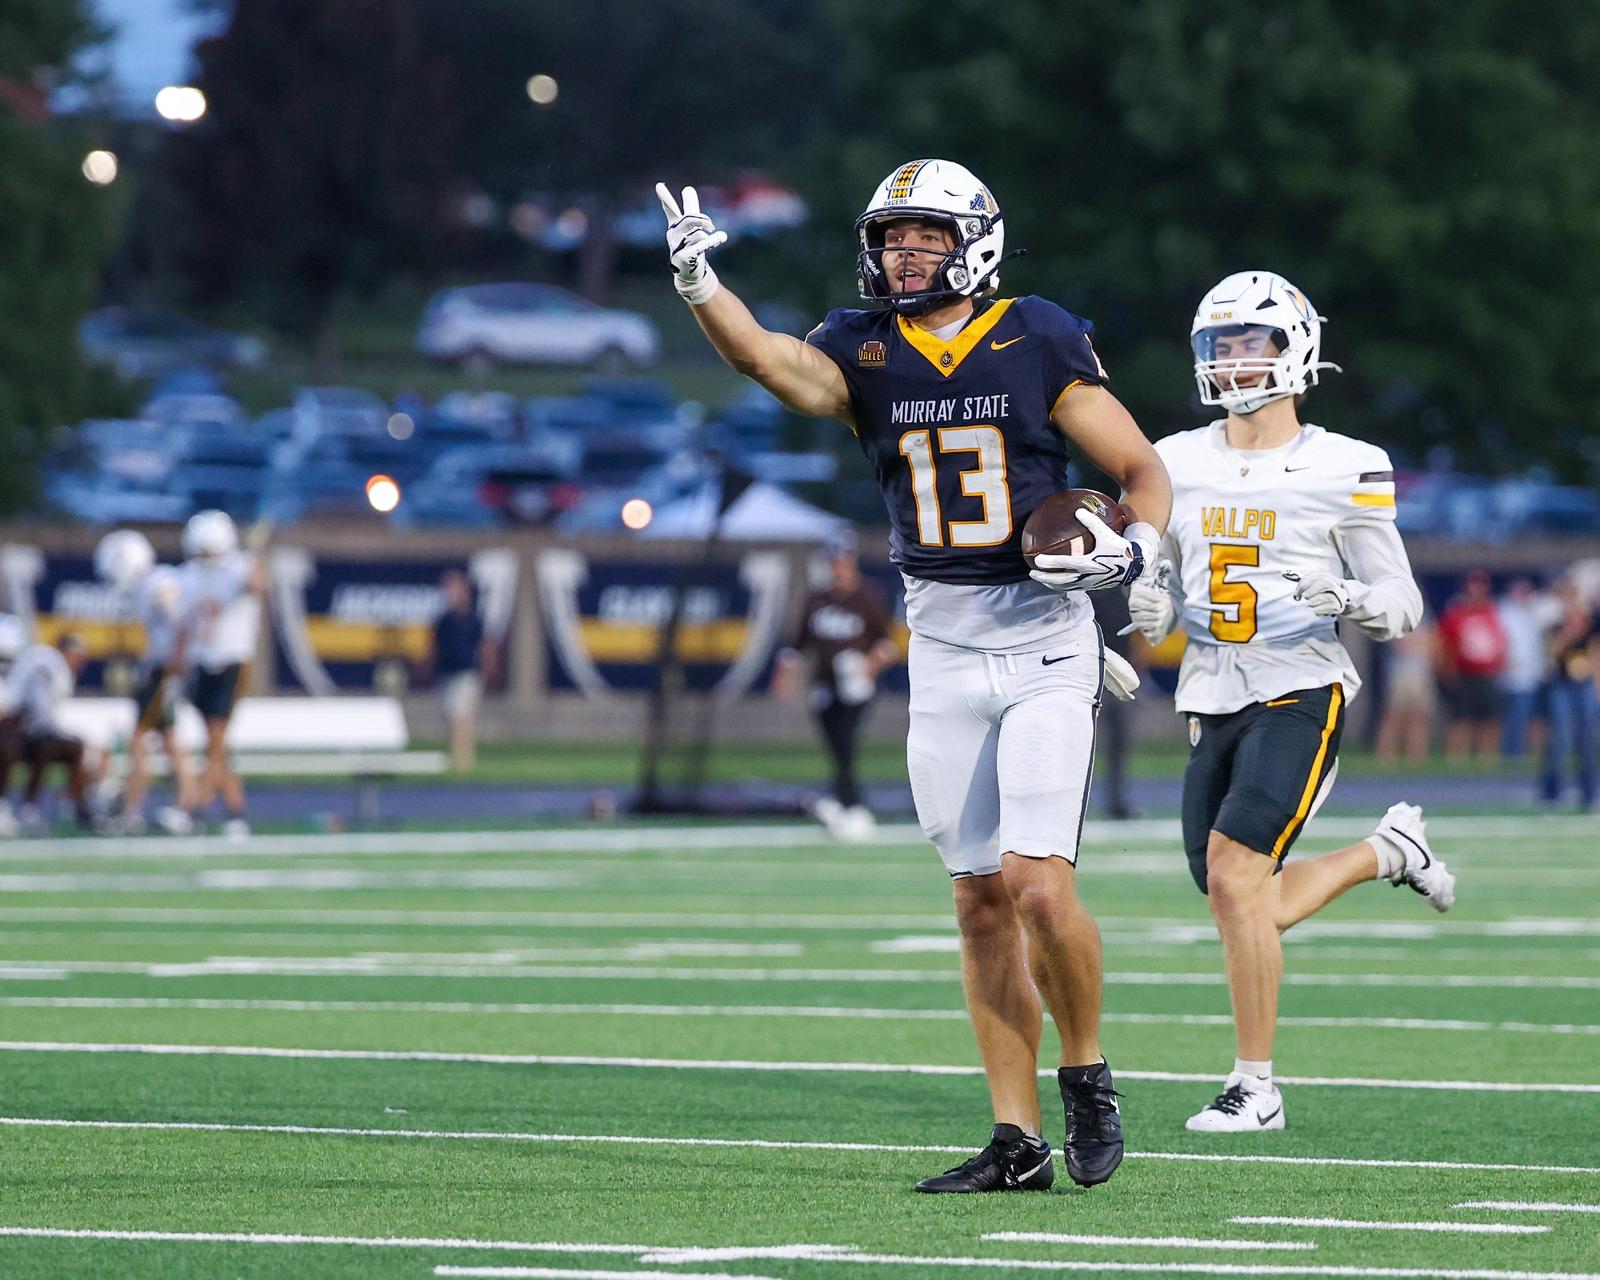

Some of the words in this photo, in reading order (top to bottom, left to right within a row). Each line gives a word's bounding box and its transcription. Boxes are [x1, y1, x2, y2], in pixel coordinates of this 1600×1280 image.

[858, 347, 887, 361] VALLEY
[891, 398, 957, 424] MURRAY
[963, 393, 1009, 420] STATE
[898, 424, 1014, 548] 13
[1201, 507, 1276, 541] VALPO
[1208, 542, 1260, 644] 5
